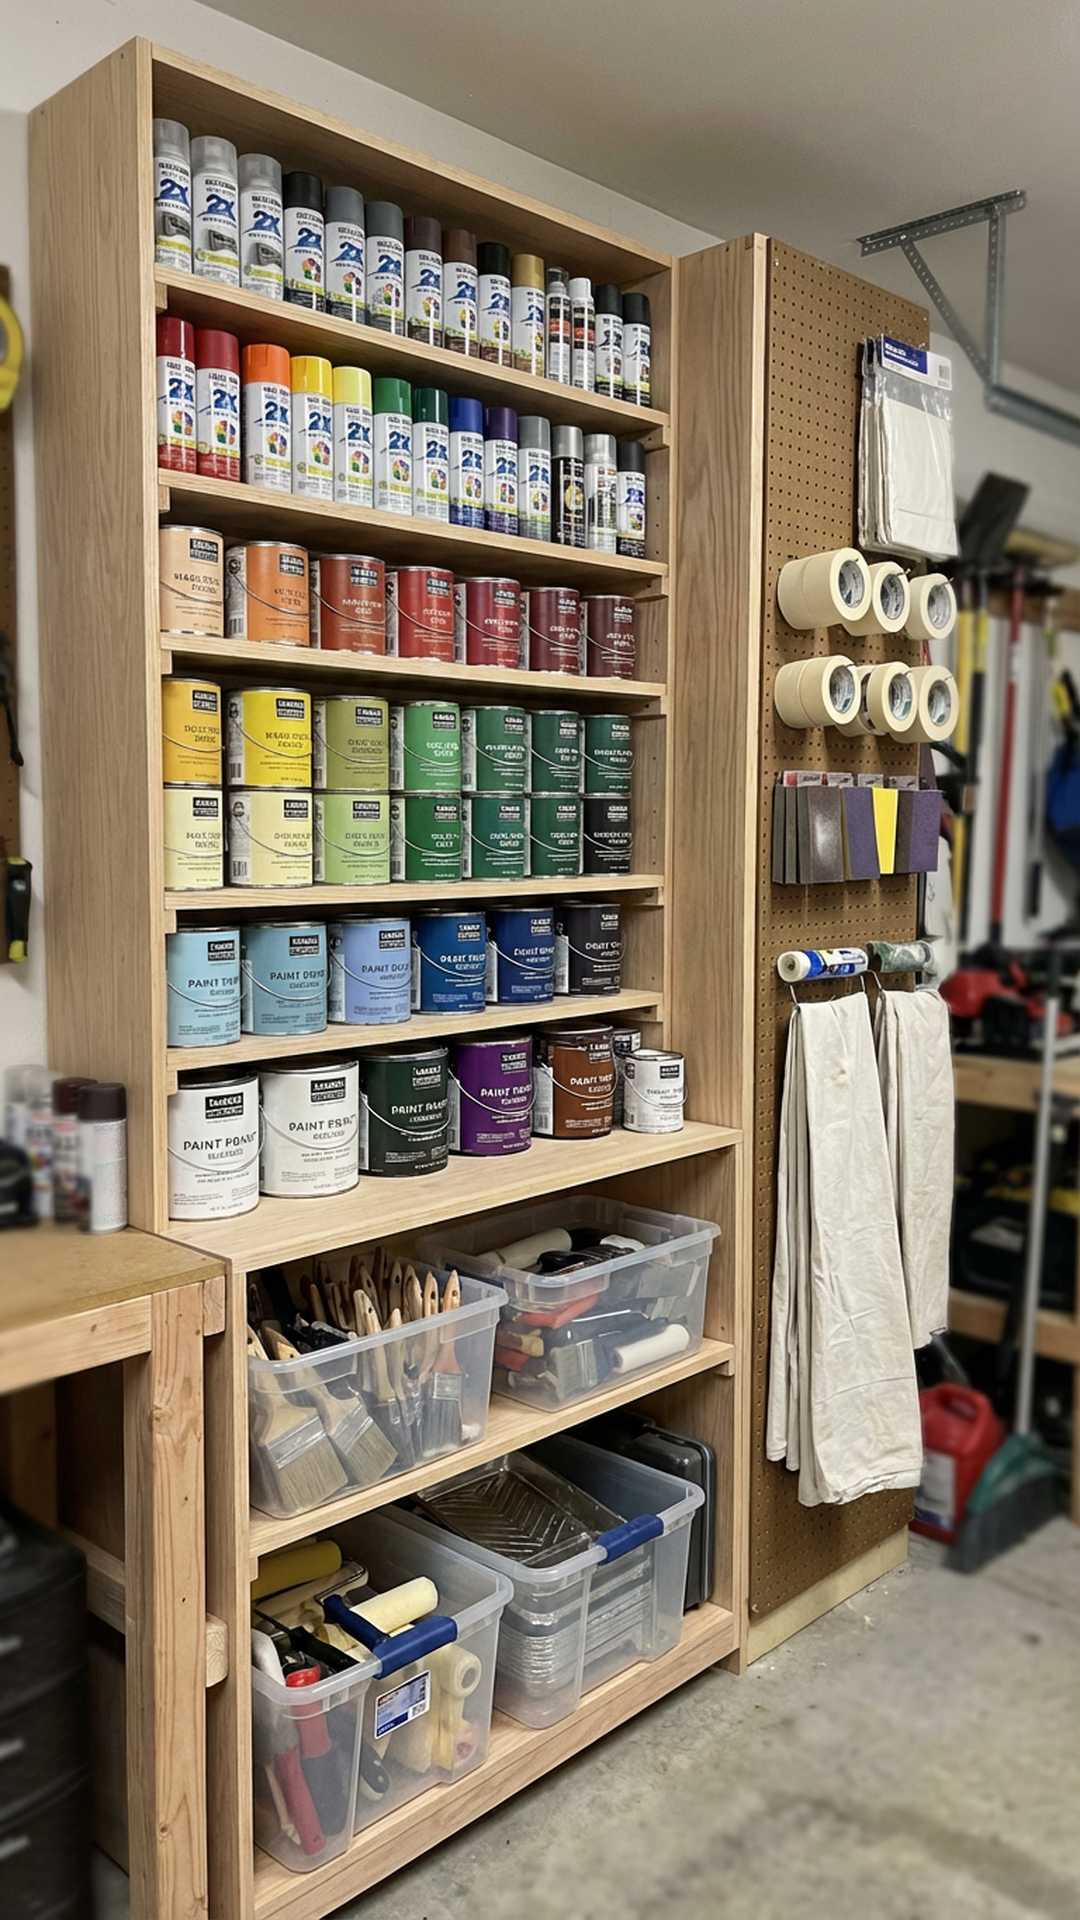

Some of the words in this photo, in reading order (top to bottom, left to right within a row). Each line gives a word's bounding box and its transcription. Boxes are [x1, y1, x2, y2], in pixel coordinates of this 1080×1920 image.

[204, 194, 236, 221] 2X
[168, 378, 194, 402] 2X
[212, 389, 238, 413] 2X
[264, 401, 289, 425] 2X
[308, 412, 331, 434] 2X
[347, 422, 371, 445] 2X
[188, 979, 219, 989] PAINT
[392, 1106, 423, 1116] PAINT
[289, 1122, 324, 1132] PAINT
[184, 1138, 222, 1151] PAINT
